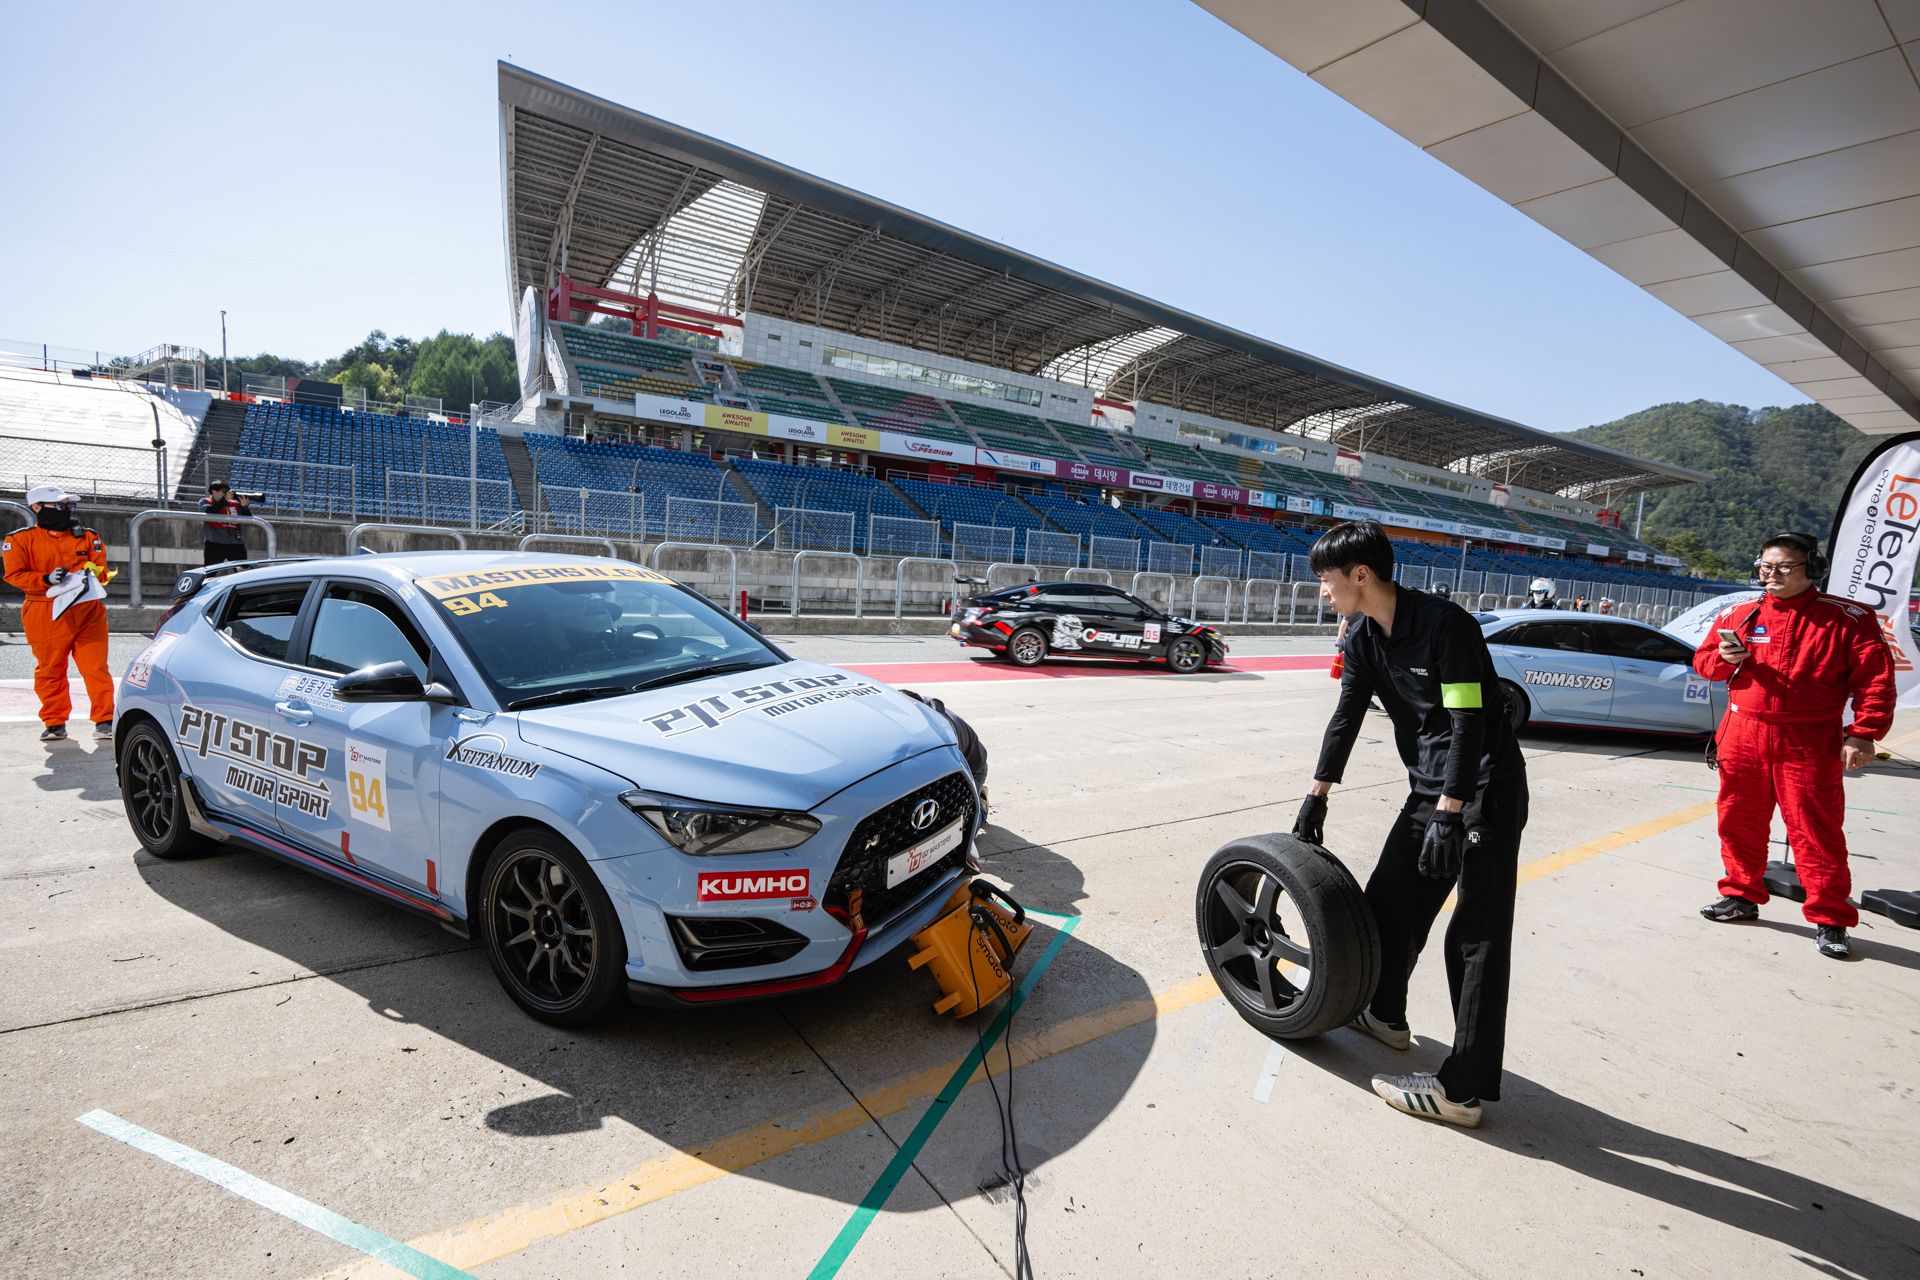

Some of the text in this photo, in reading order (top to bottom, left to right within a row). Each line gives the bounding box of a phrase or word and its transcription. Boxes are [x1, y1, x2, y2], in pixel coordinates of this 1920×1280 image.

[659, 408, 691, 417] LEGOLAND
[722, 412, 753, 422] AWESOME
[724, 419, 750, 428] AWAITS!
[788, 427, 815, 436] LEGOLAND
[840, 431, 867, 439] AWESOME
[911, 442, 953, 457] SPEEDIUM
[1094, 468, 1117, 482] 데시앙
[1136, 477, 1191, 493] TAEYOUNG 태영건설
[1221, 488, 1240, 500] 데시앙
[433, 567, 584, 592] MASTERS
[442, 592, 508, 616] 94
[1145, 629, 1159, 641] 05
[1524, 670, 1613, 691] THOMAS789
[765, 684, 882, 718] MOTOR SPORT
[1686, 684, 1708, 700] 64
[642, 673, 849, 732] PIT STOP
[179, 705, 327, 777] PIT STOP
[447, 737, 543, 778] XTITANIUM
[225, 765, 332, 819] MOTOR SPORT
[349, 771, 385, 819] 94
[701, 874, 807, 895] KUMHO
[976, 935, 1004, 979] smato
